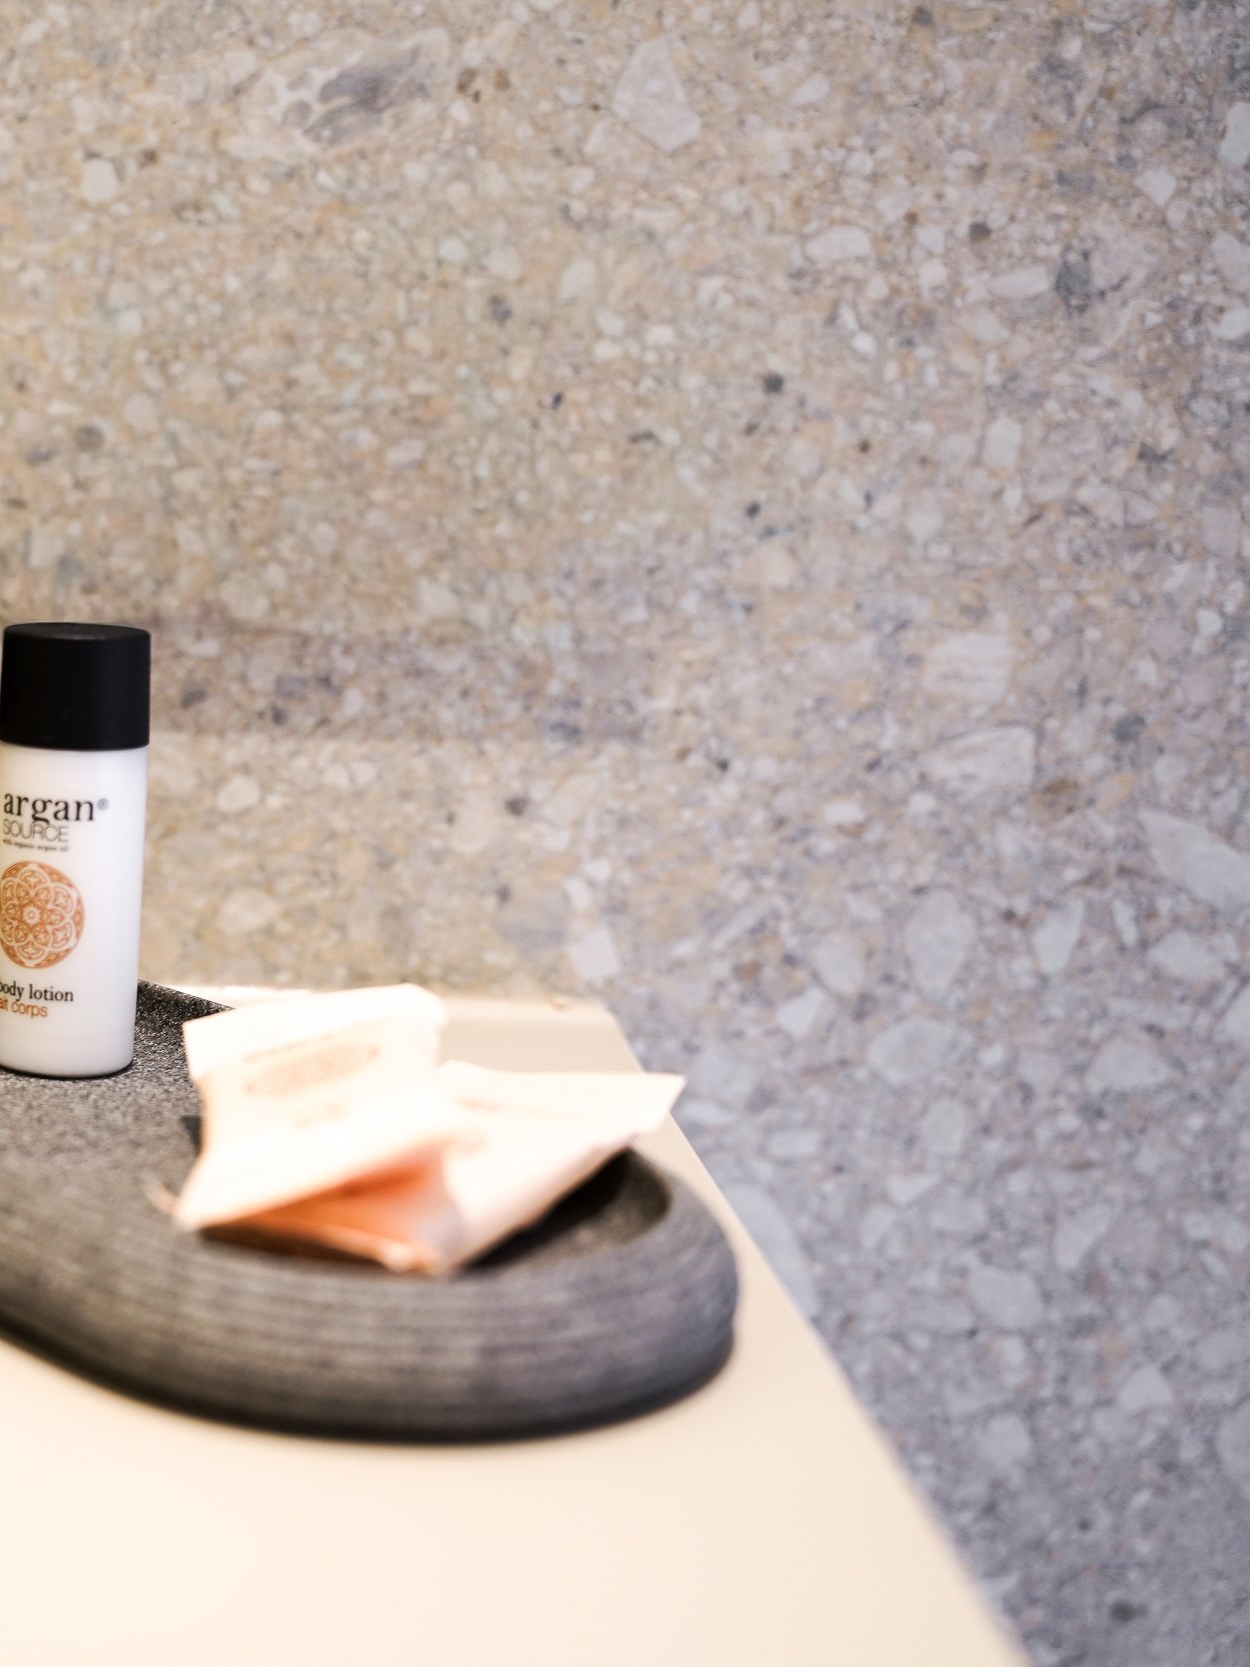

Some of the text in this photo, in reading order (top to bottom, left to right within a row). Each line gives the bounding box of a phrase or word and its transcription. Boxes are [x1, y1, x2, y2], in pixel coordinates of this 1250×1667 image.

[3, 818, 69, 842] SOURCE
[29, 984, 74, 1002] lotion
[11, 1001, 48, 1019] corps
